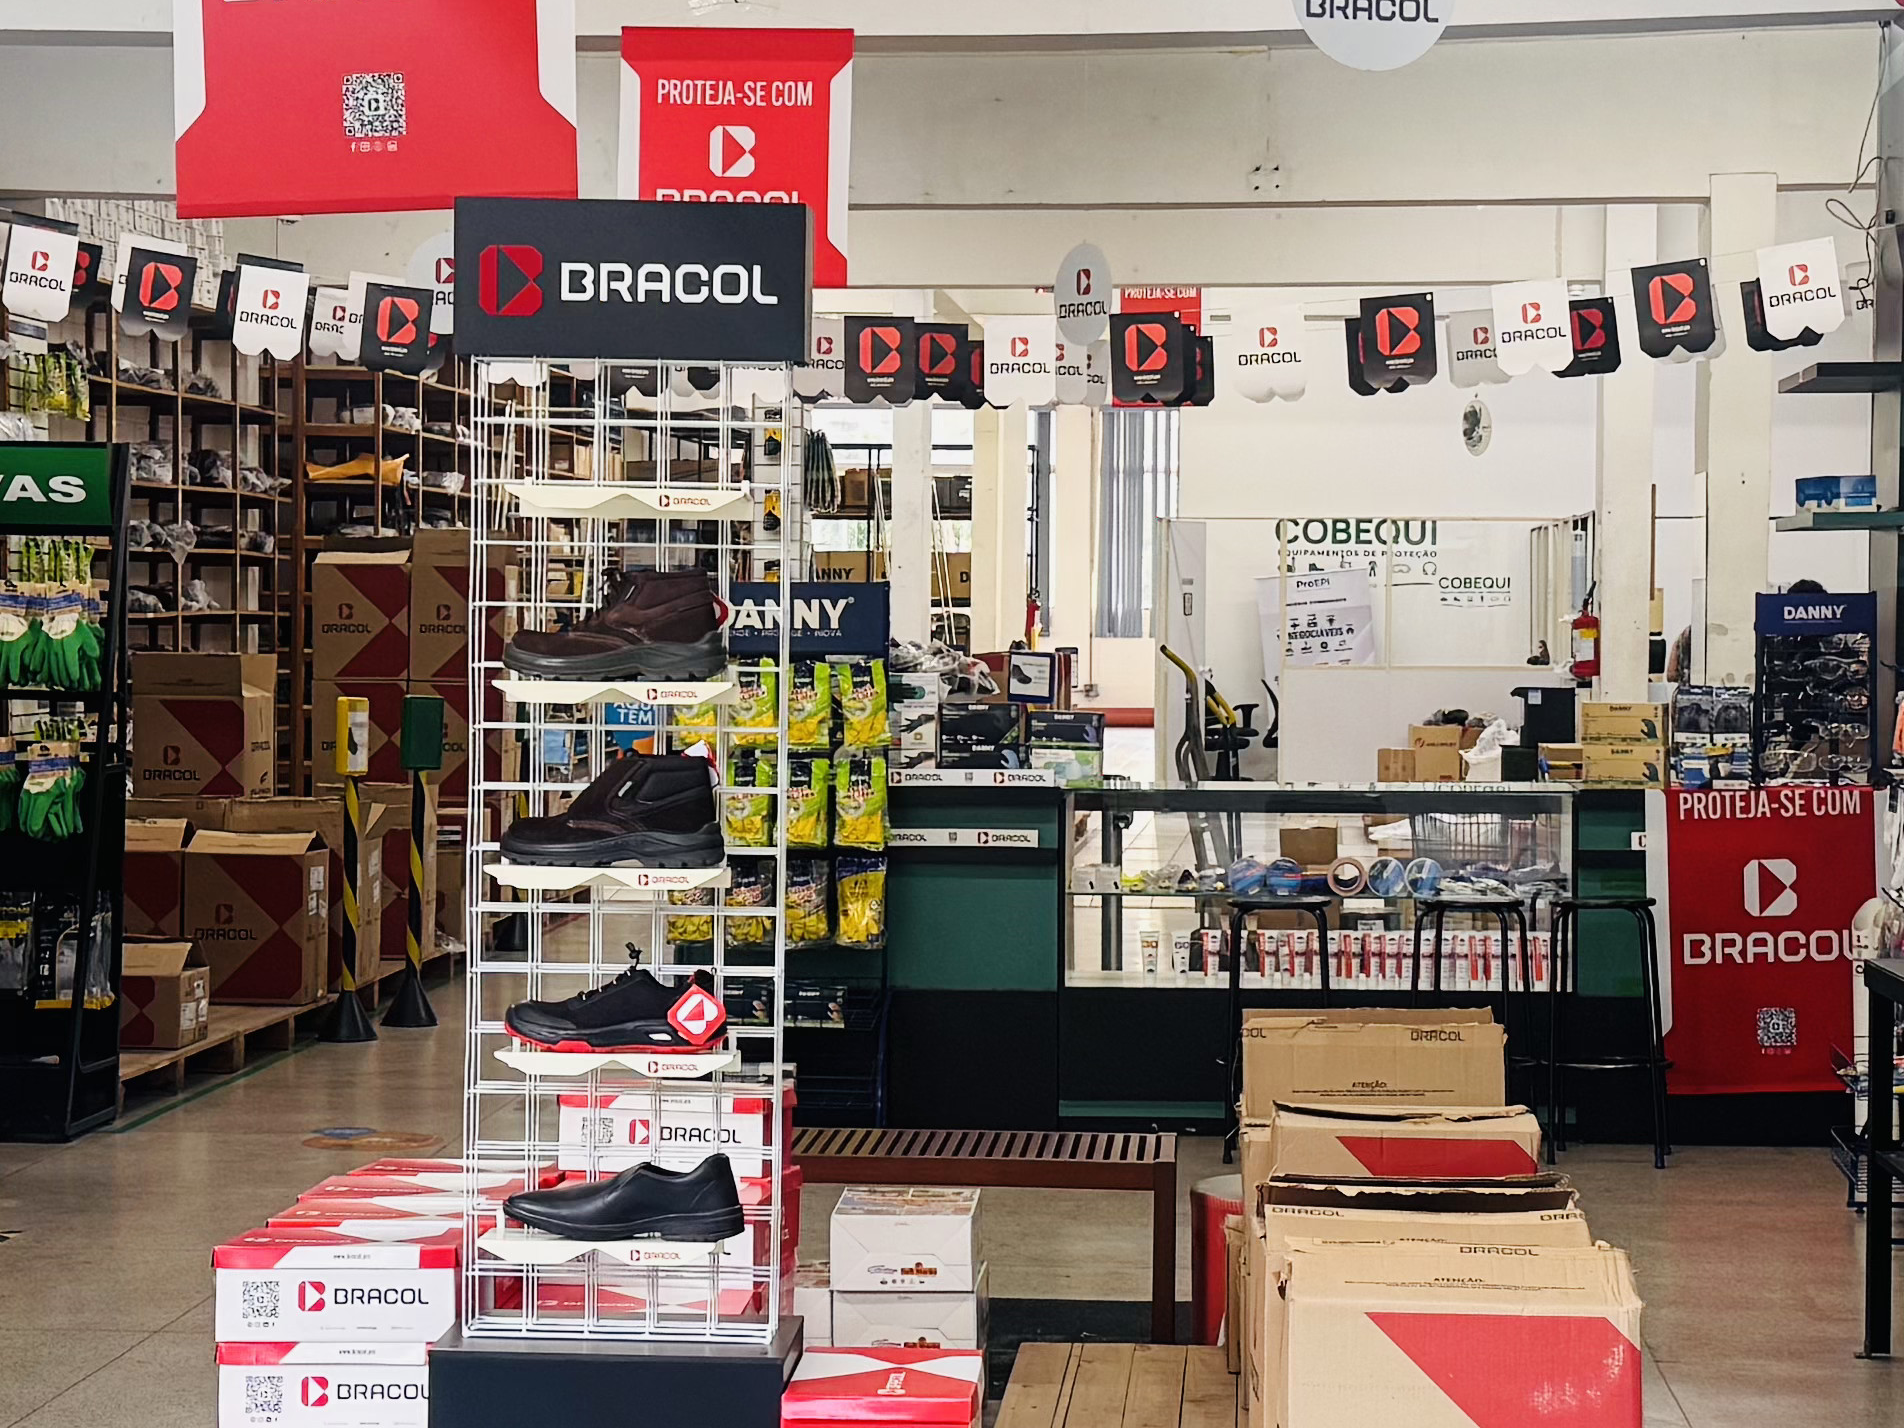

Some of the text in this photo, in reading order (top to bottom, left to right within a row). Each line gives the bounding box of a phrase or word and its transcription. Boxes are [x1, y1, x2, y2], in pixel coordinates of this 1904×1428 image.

[656, 78, 814, 107] PROTEJA-SE COM
[9, 271, 67, 293] BRACOL
[559, 262, 779, 305] BRACOL
[1769, 286, 1837, 308] BRACOL
[1058, 299, 1108, 320] BRACOL
[239, 310, 298, 330] BRACOL
[1501, 327, 1567, 344] BRACOL
[1238, 352, 1302, 366] BRACOL
[1456, 348, 1496, 361] BRAC
[989, 362, 1052, 375] BRACOL
[1275, 518, 1437, 547] COBEQUI
[1439, 576, 1511, 590] COBEQUI
[1784, 605, 1844, 620] DANNY
[320, 623, 372, 634] BRACOL
[616, 707, 653, 725] TEM
[143, 769, 201, 782] BRACOL
[904, 772, 944, 783] BRACOL
[1006, 772, 1047, 783] BRACOL
[1679, 788, 1862, 821] PROTEJA-SE COM
[991, 832, 1031, 843] BRACOL
[1683, 929, 1855, 965] BRACOL
[1411, 1030, 1466, 1042] BRACOL
[661, 1125, 742, 1145] BRACOL
[1271, 1206, 1345, 1217] BRACOL
[1460, 1245, 1539, 1256] BRACOL
[333, 1287, 429, 1305] BRACOL
